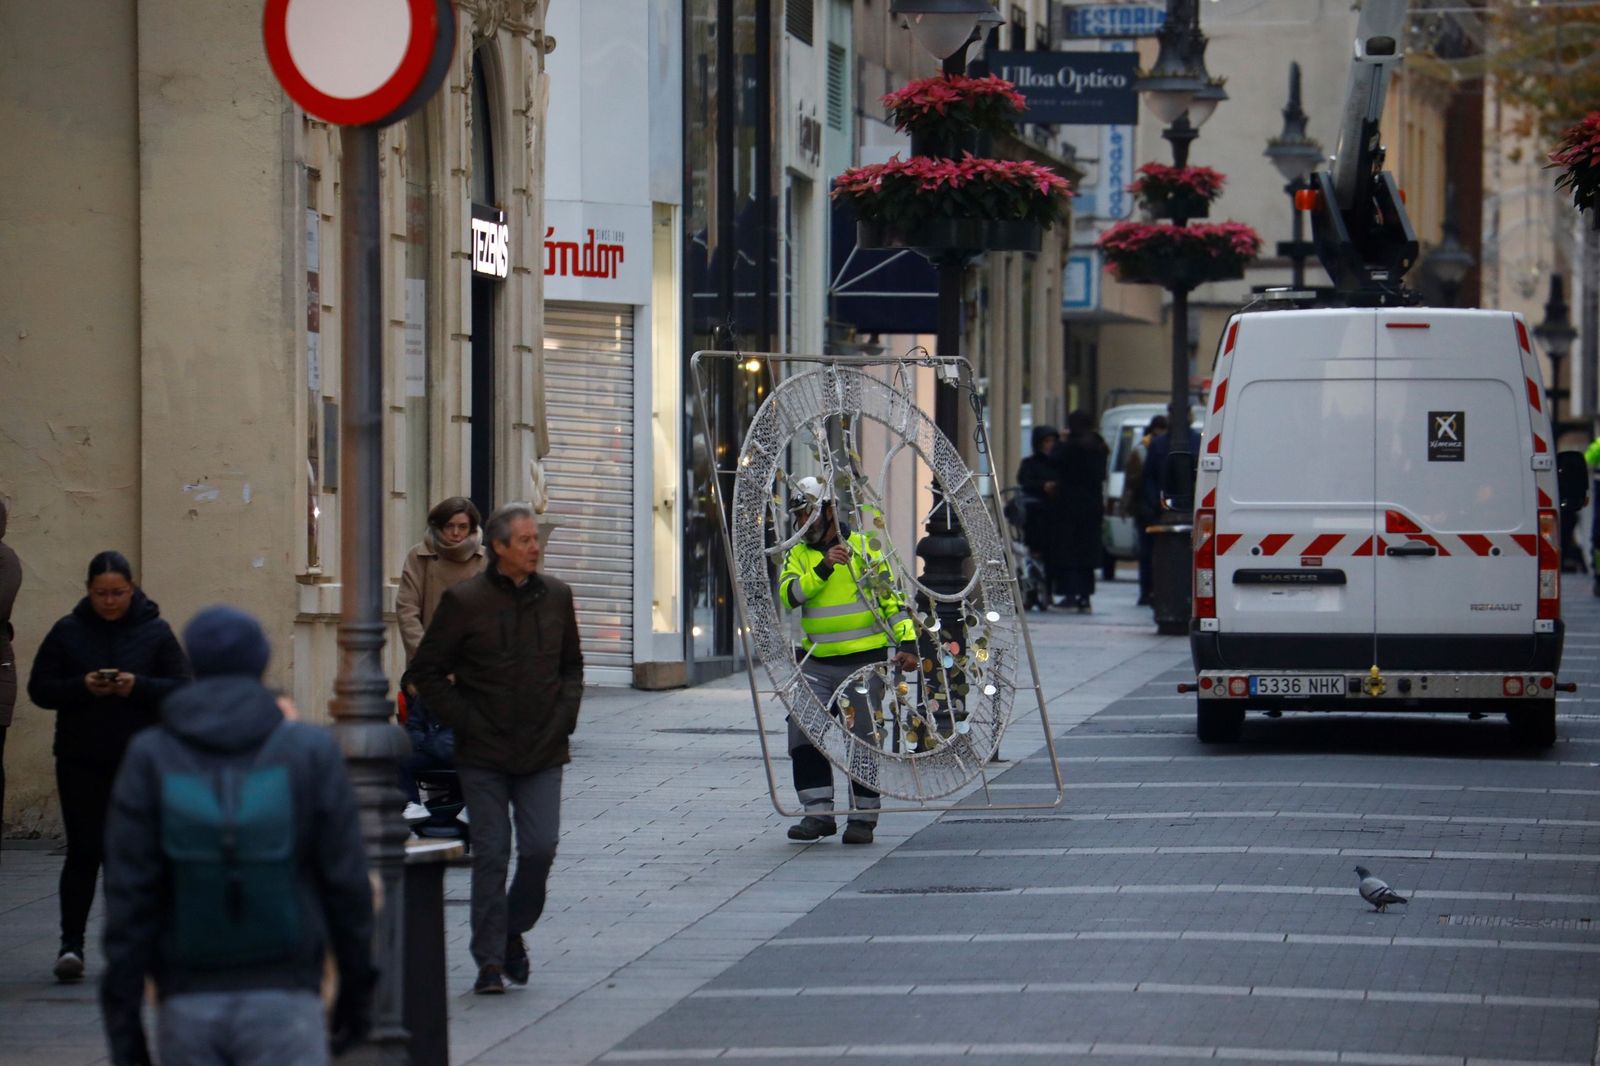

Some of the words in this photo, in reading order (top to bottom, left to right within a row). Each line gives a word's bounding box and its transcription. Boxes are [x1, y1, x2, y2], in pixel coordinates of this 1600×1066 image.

[1001, 66, 1056, 87] Ulloa
[1057, 66, 1127, 93] Optico
[472, 210, 509, 279] TEZENIS
[1260, 573, 1319, 582] MASTER
[1470, 603, 1522, 611] RENAULT
[1259, 678, 1302, 693] 5336
[1308, 678, 1340, 693] NHK
